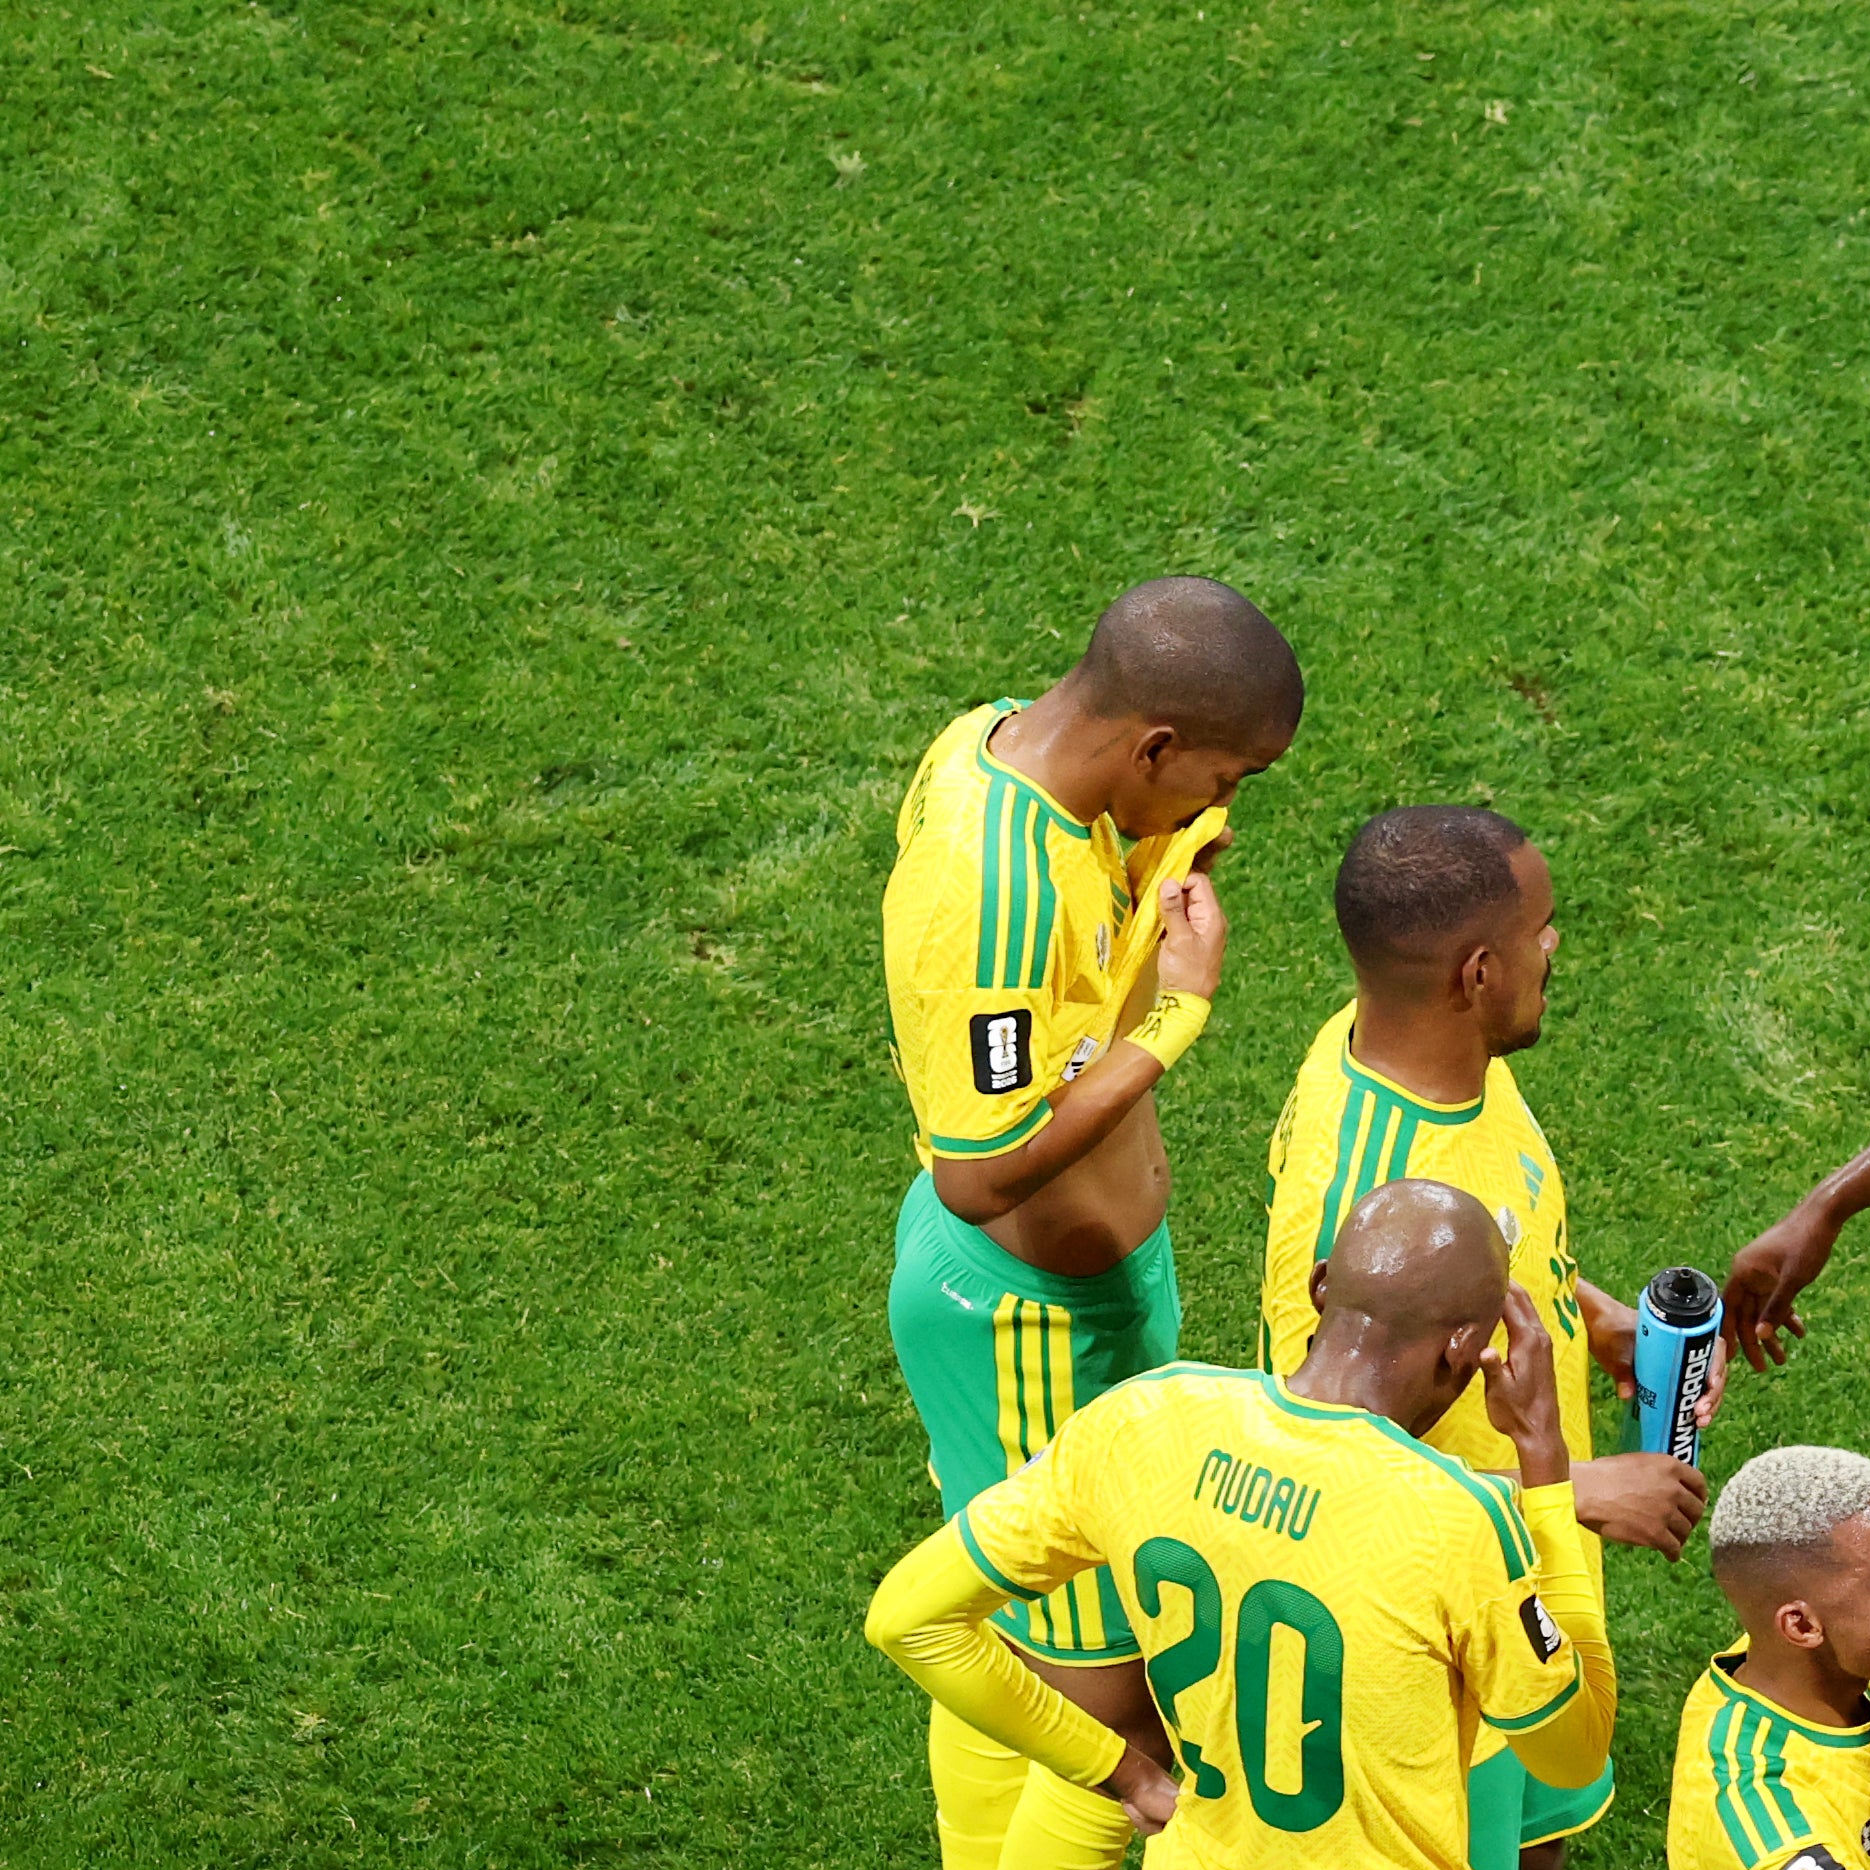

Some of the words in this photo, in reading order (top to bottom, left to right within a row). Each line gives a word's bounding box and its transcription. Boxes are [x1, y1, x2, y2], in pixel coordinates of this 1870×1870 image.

[1672, 1346, 1712, 1466] OWERADE
[1193, 1448, 1322, 1541] MUDAU
[1132, 1536, 1345, 1834] 20
